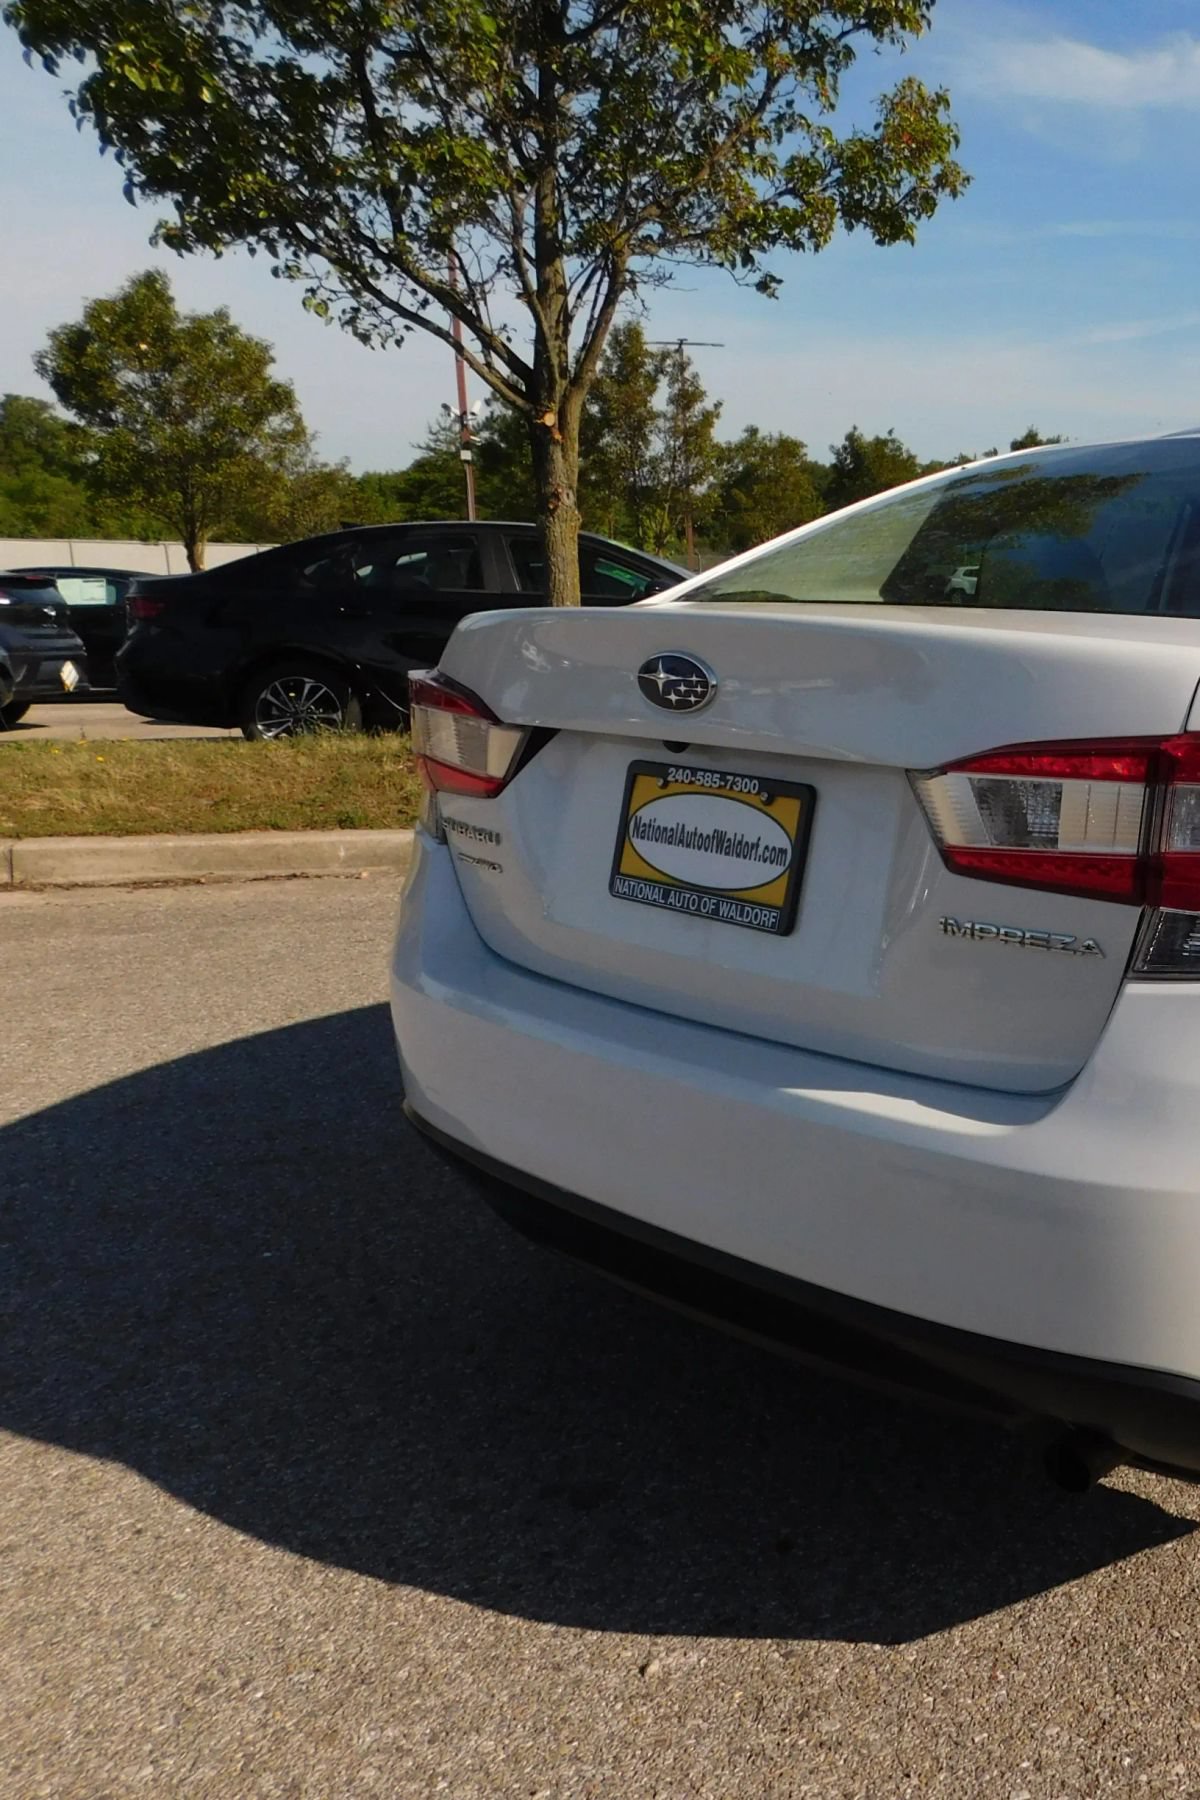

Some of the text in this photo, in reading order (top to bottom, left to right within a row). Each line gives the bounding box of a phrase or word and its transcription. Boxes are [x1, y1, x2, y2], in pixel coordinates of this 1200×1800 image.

[667, 767, 760, 795] 240-585-7300
[632, 815, 788, 868] NationalAutoofWaldorf.com
[614, 878, 778, 929] NATIONAL AUTO OF WALDORF
[938, 915, 1106, 958] IMPREZA
